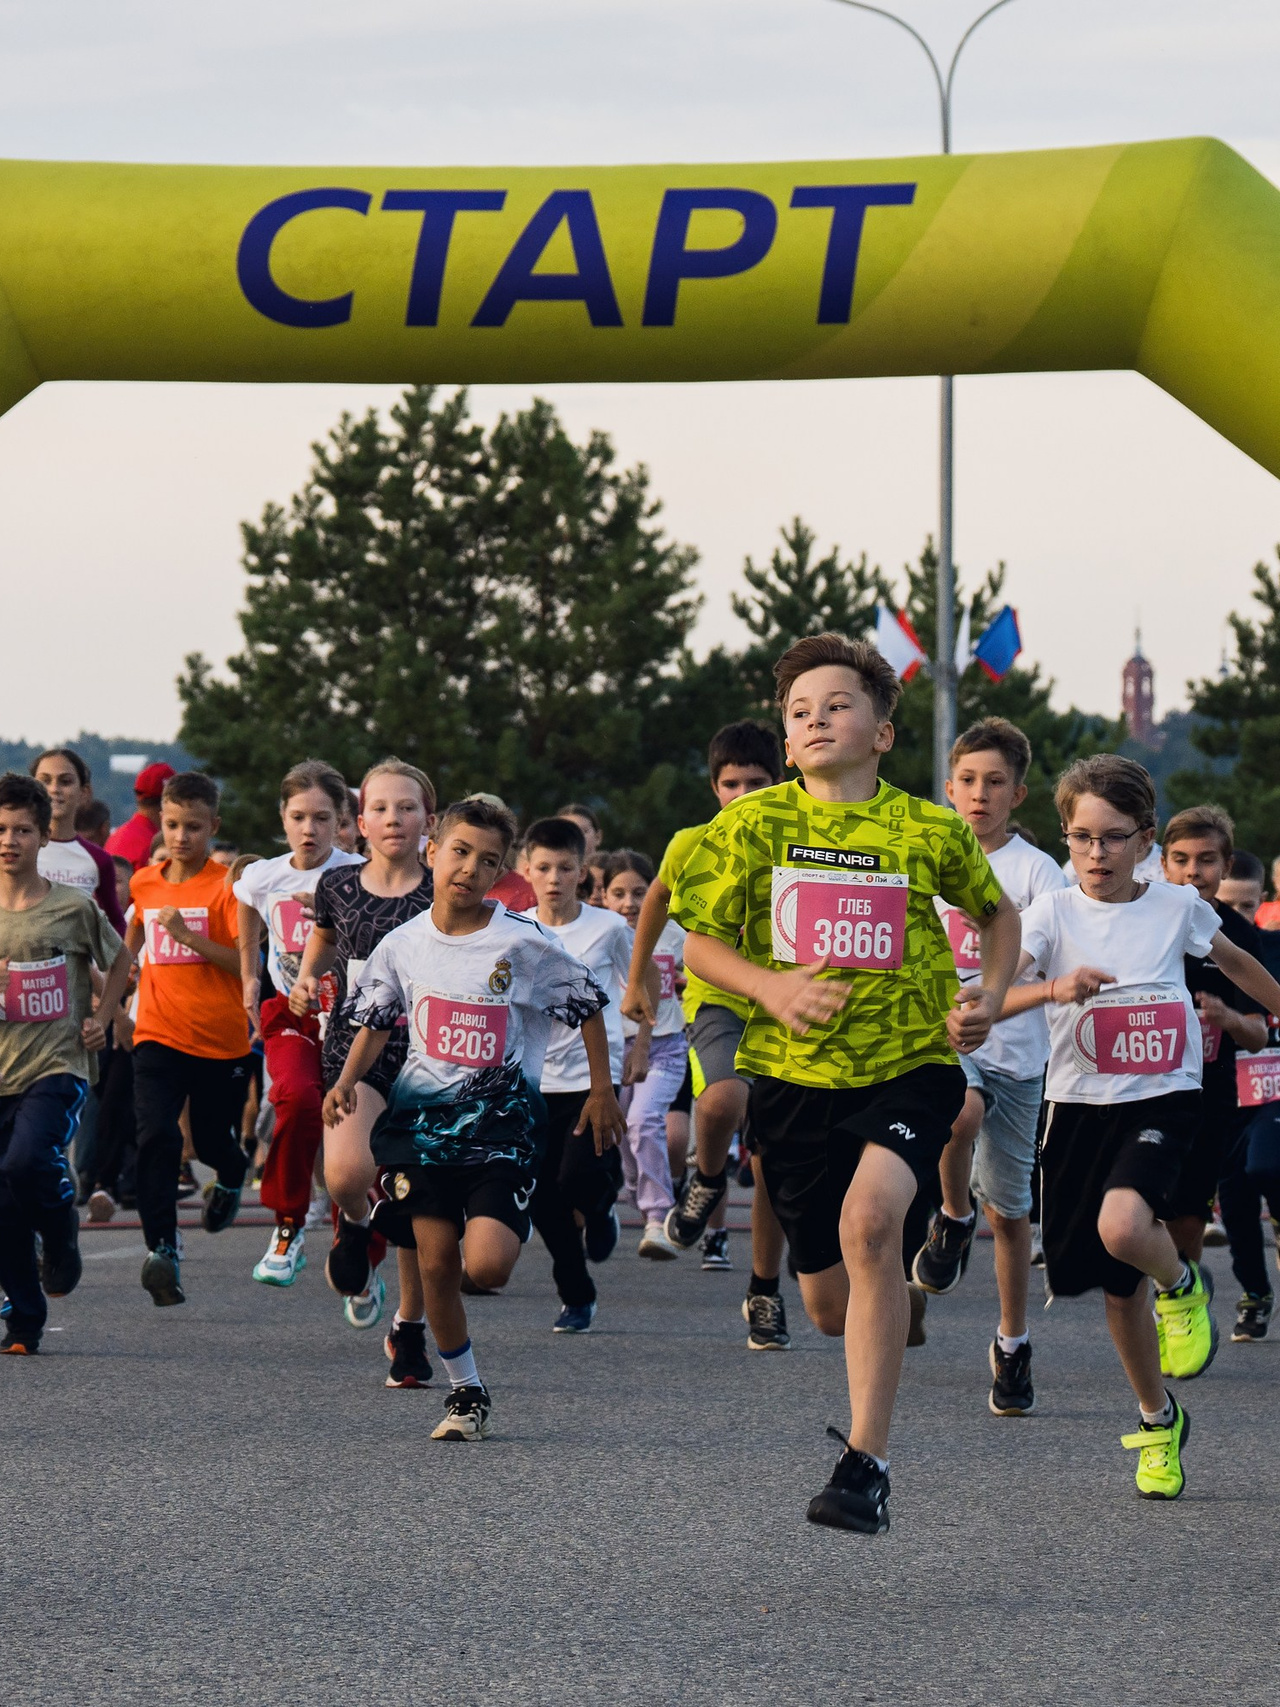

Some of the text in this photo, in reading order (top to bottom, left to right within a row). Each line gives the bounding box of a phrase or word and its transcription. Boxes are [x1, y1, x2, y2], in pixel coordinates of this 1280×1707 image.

[236, 182, 917, 328] СТАРТ
[887, 805, 905, 847] NRG
[792, 848, 875, 867] FREE NRG
[838, 898, 872, 915] ГЛЕБ
[813, 918, 893, 960] 3866
[22, 974, 56, 990] МАТВЕЙ
[17, 987, 64, 1017] 1600
[450, 1011, 487, 1029] ДАВИД
[1128, 1011, 1157, 1027] ОЛЕГ
[437, 1025, 497, 1060] 3203
[1111, 1028, 1178, 1063] 4667
